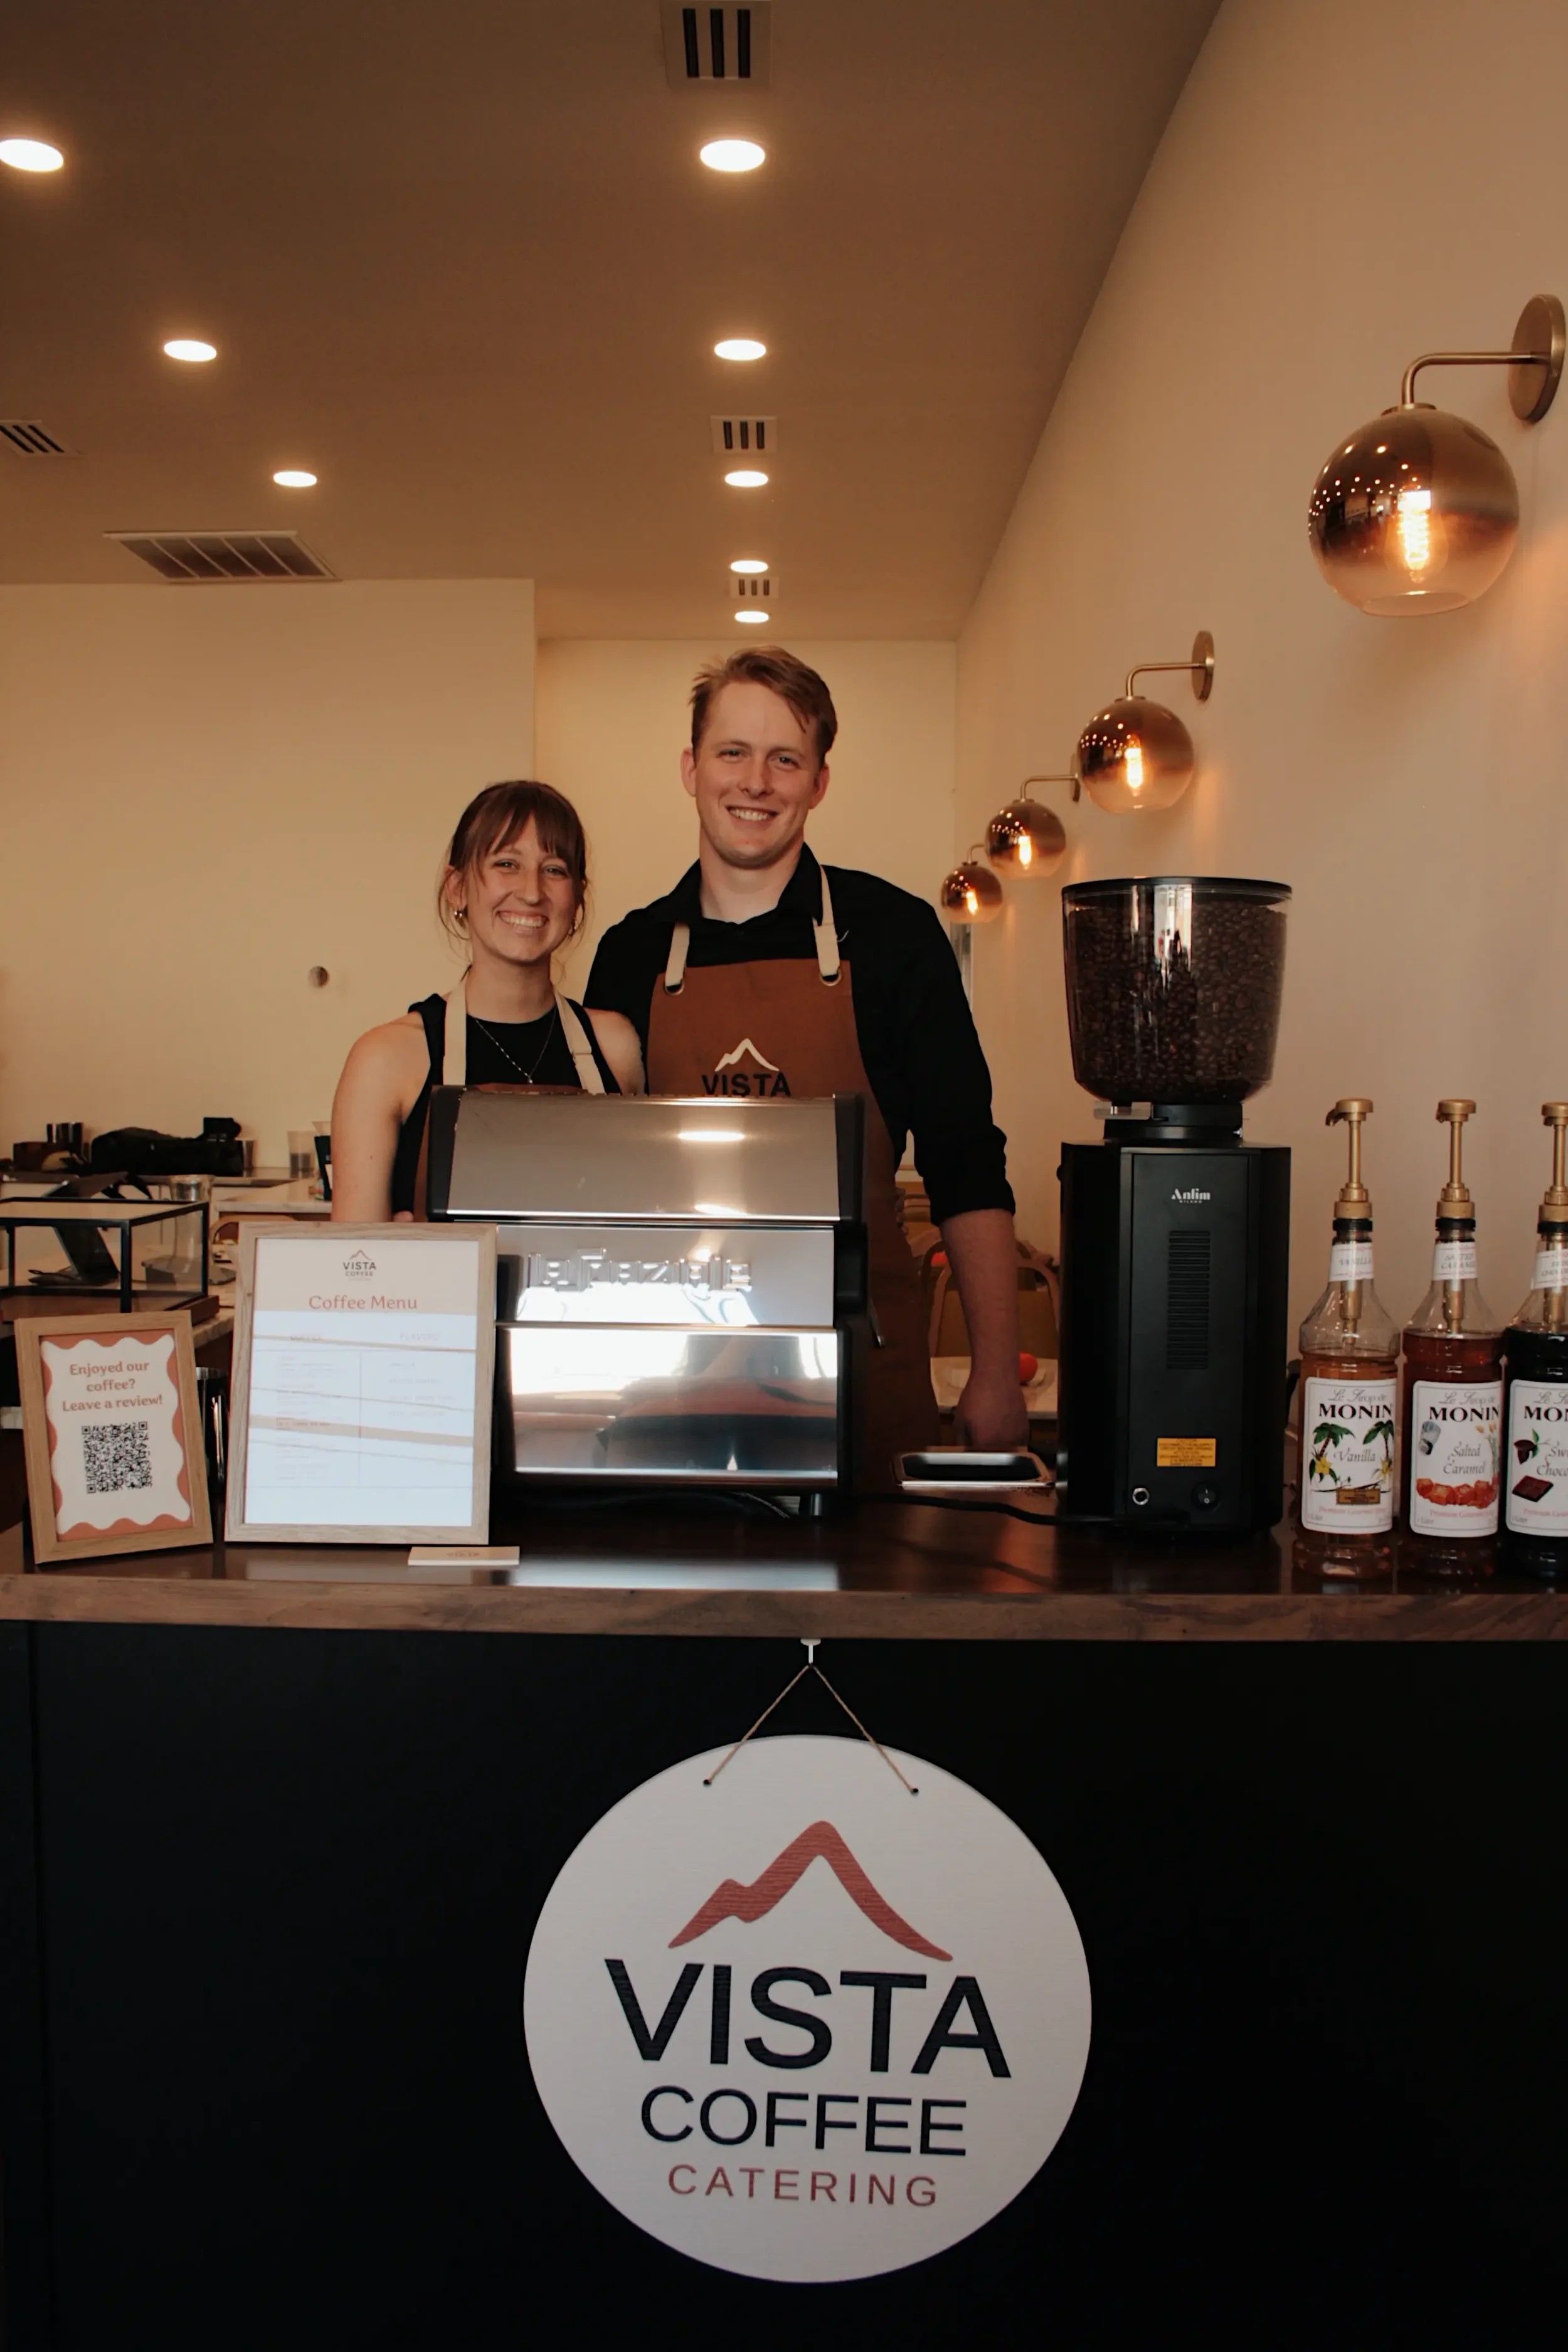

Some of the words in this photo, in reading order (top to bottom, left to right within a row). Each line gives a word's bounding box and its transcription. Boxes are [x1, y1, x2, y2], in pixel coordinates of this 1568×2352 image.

[702, 1072, 792, 1096] VISTA
[342, 1261, 377, 1271] VISTA
[309, 1295, 366, 1310] Coffee
[371, 1295, 418, 1310] Menu
[70, 1361, 124, 1377] Enjoyed
[126, 1361, 150, 1372] our
[86, 1378, 136, 1392] coffee?
[62, 1400, 102, 1412] Leave
[104, 1401, 114, 1409] a
[115, 1394, 163, 1408] review!
[1318, 1403, 1392, 1420] MONIN
[1429, 1406, 1500, 1423] MONIN
[1333, 1446, 1376, 1463] Vanilla
[1452, 1441, 1481, 1458] Salted
[1443, 1455, 1486, 1475] Caramel
[604, 1958, 1012, 2079] VISTA
[640, 2085, 967, 2156] COFFEE
[667, 2164, 938, 2206] CATERING
